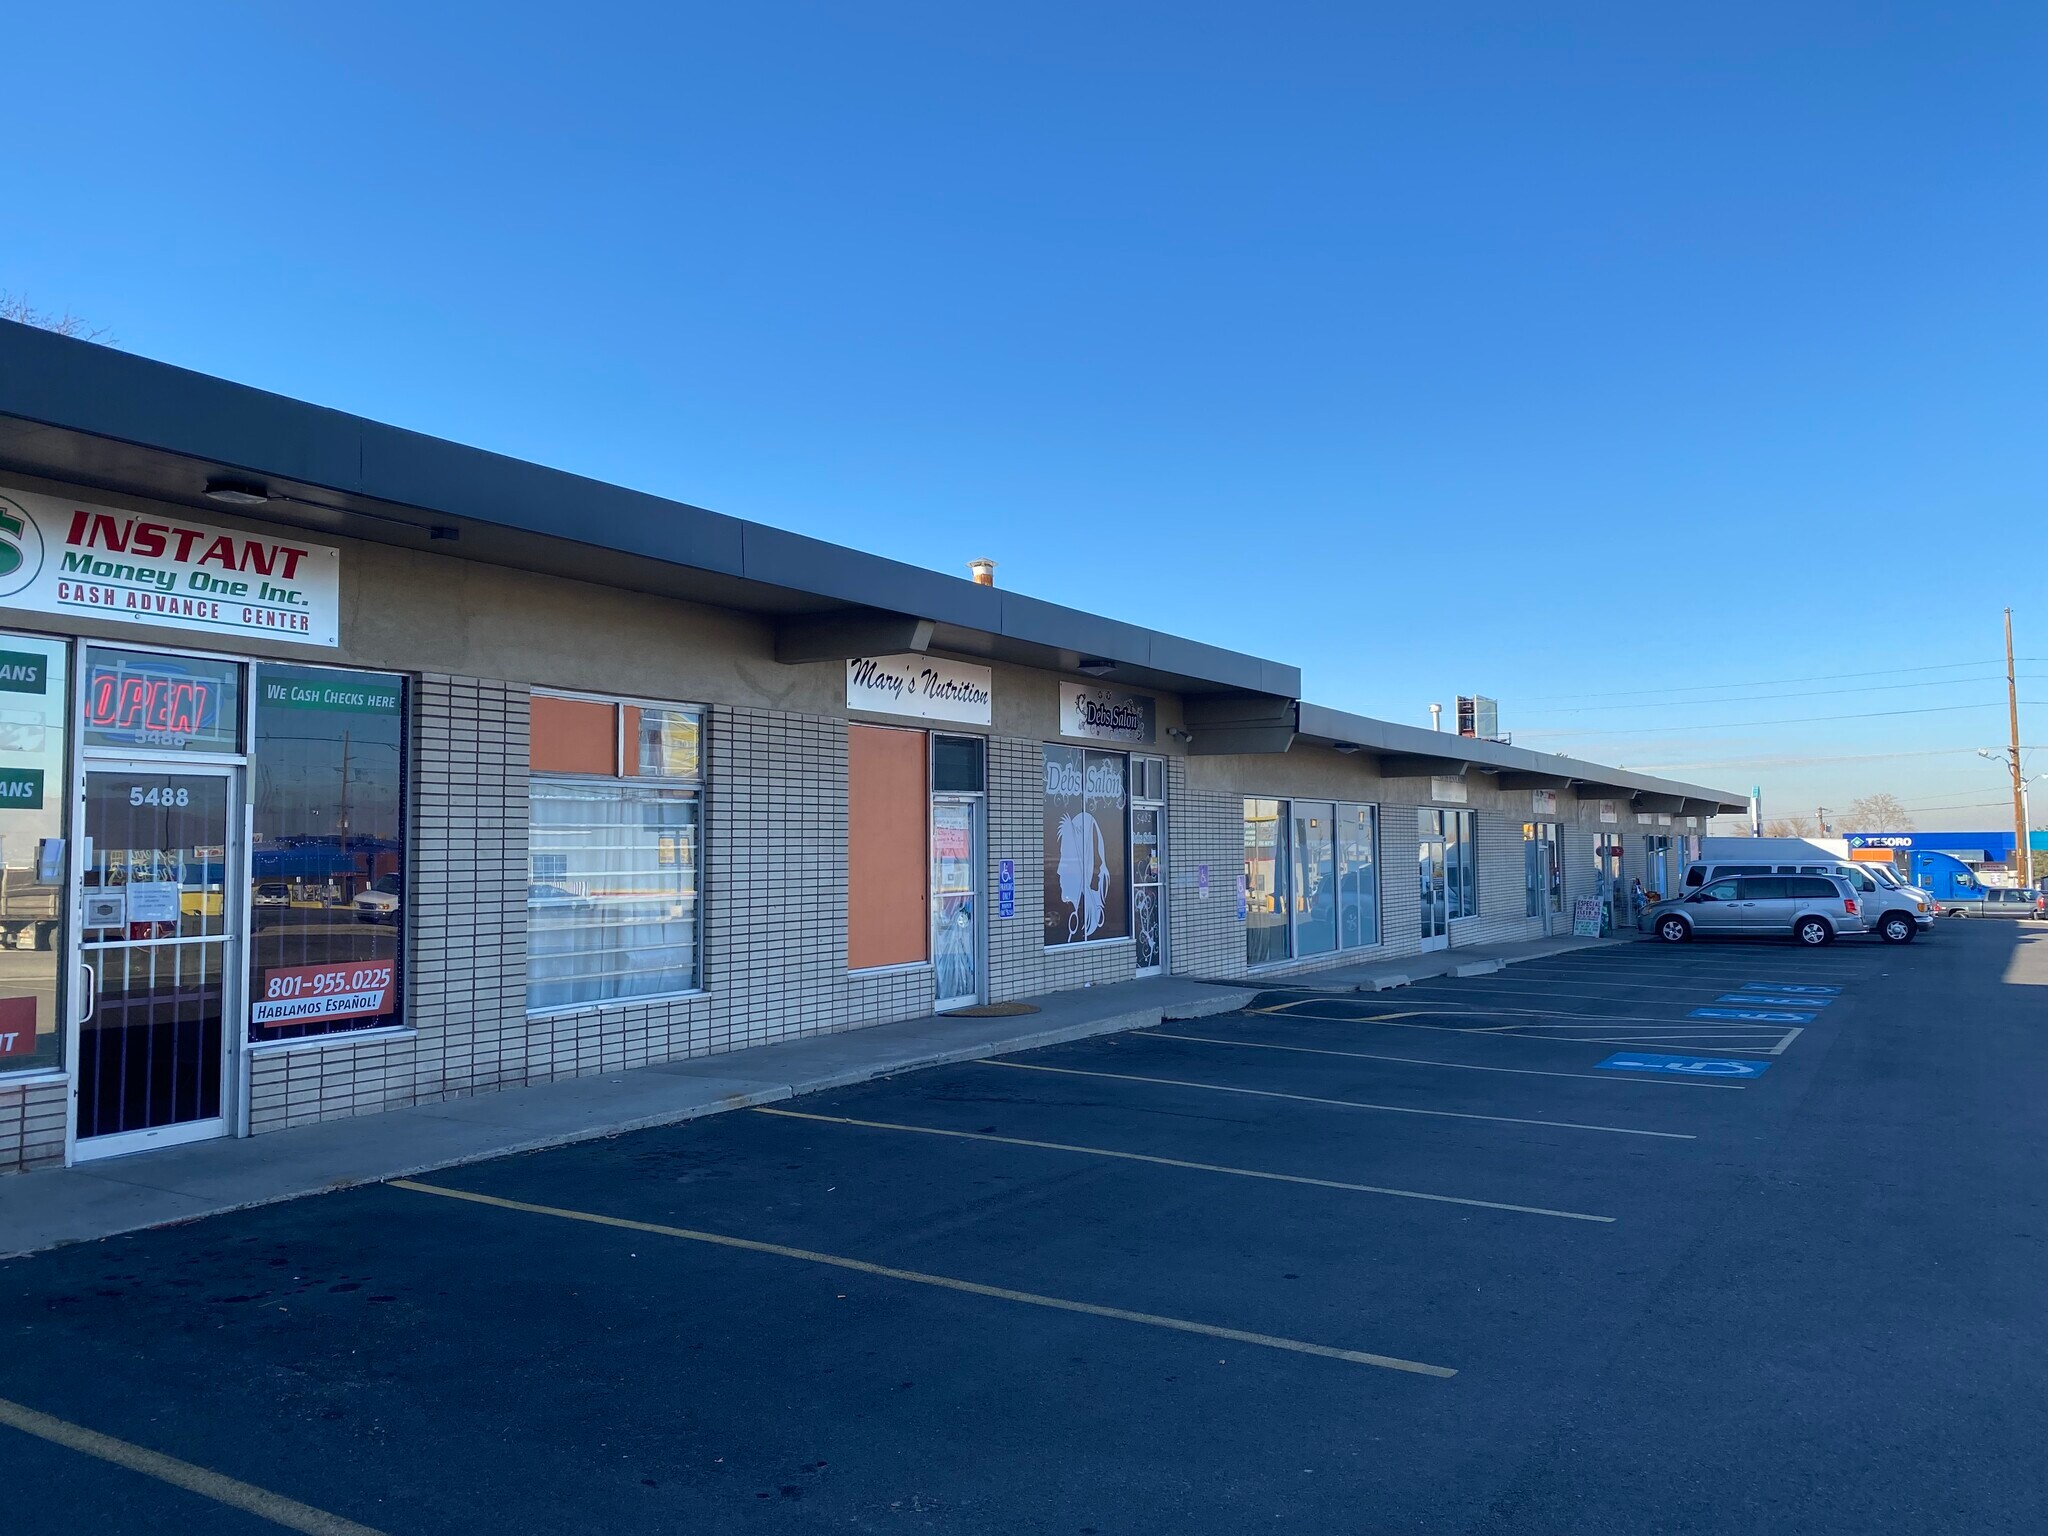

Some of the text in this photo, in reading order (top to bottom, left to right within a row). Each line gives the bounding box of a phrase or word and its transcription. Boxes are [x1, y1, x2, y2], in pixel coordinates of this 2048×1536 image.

[66, 510, 309, 580] INSTANT
[60, 551, 309, 606] Money One Inc.
[58, 582, 309, 631] CASH ADVANCE CENTER
[851, 658, 988, 705] Mary's Nutrition
[86, 675, 207, 733] OPEN
[1087, 701, 1138, 730] Debs Salon
[129, 786, 189, 807] 5488
[1047, 764, 1122, 796] Debs Salon
[1865, 837, 1912, 847] TESORO
[267, 968, 391, 998] 801-955.0225
